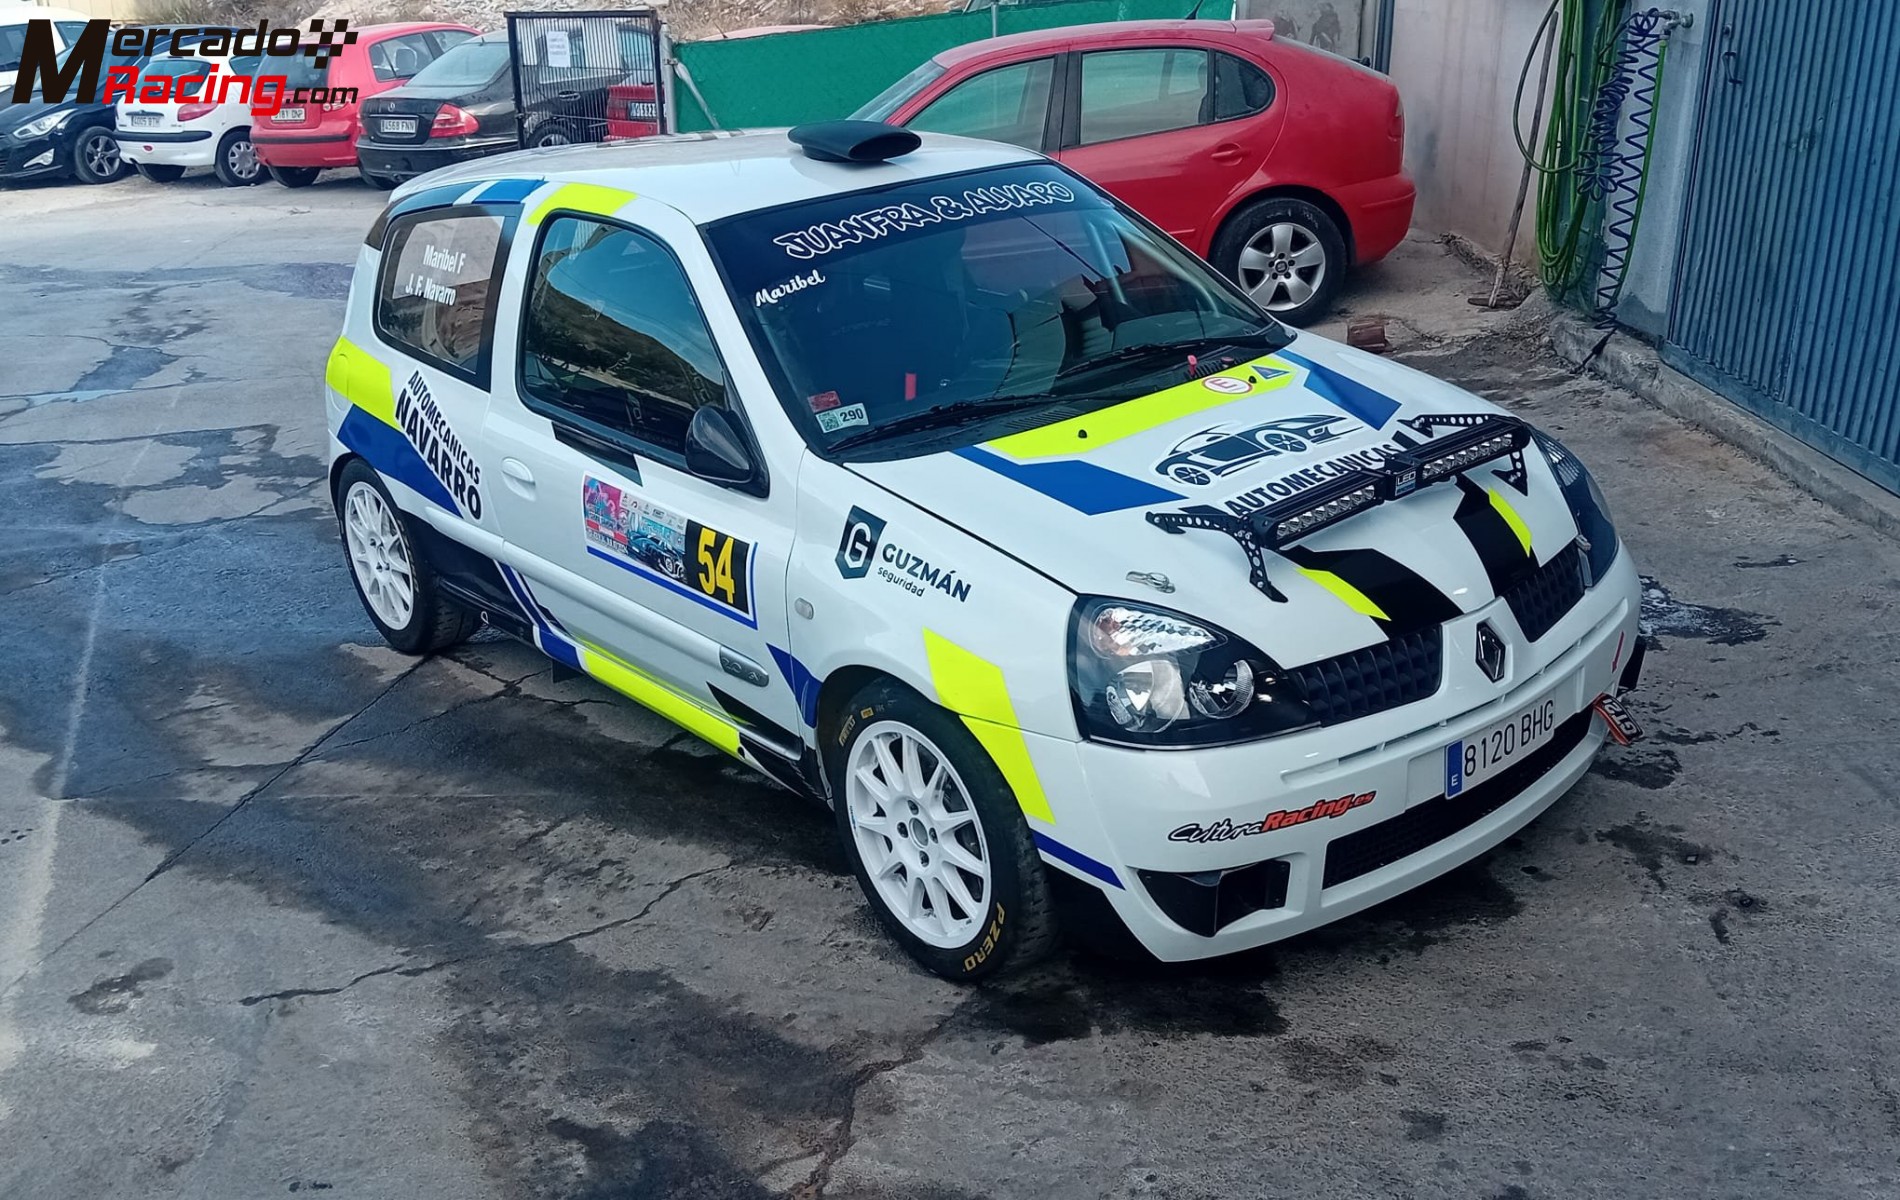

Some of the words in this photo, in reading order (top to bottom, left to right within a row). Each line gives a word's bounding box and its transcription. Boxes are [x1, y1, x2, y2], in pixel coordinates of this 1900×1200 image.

[773, 203, 942, 259] JUANFRA
[930, 196, 973, 220] &
[963, 181, 1075, 214] ALVARO
[423, 245, 458, 273] Maribel
[457, 253, 466, 274] F
[424, 277, 456, 306] Navarro
[755, 269, 825, 306] Maribel
[408, 370, 480, 485] AUTOMECANICAS
[840, 408, 864, 422] 290
[396, 388, 482, 520] NAVARRO
[1397, 471, 1416, 486] LED
[698, 527, 735, 604] 54
[877, 566, 925, 597] seguridad
[882, 543, 971, 603] GUZMÁN
[1464, 723, 1516, 778] 8120
[1521, 700, 1554, 747] BHG
[1451, 773, 1459, 787] E
